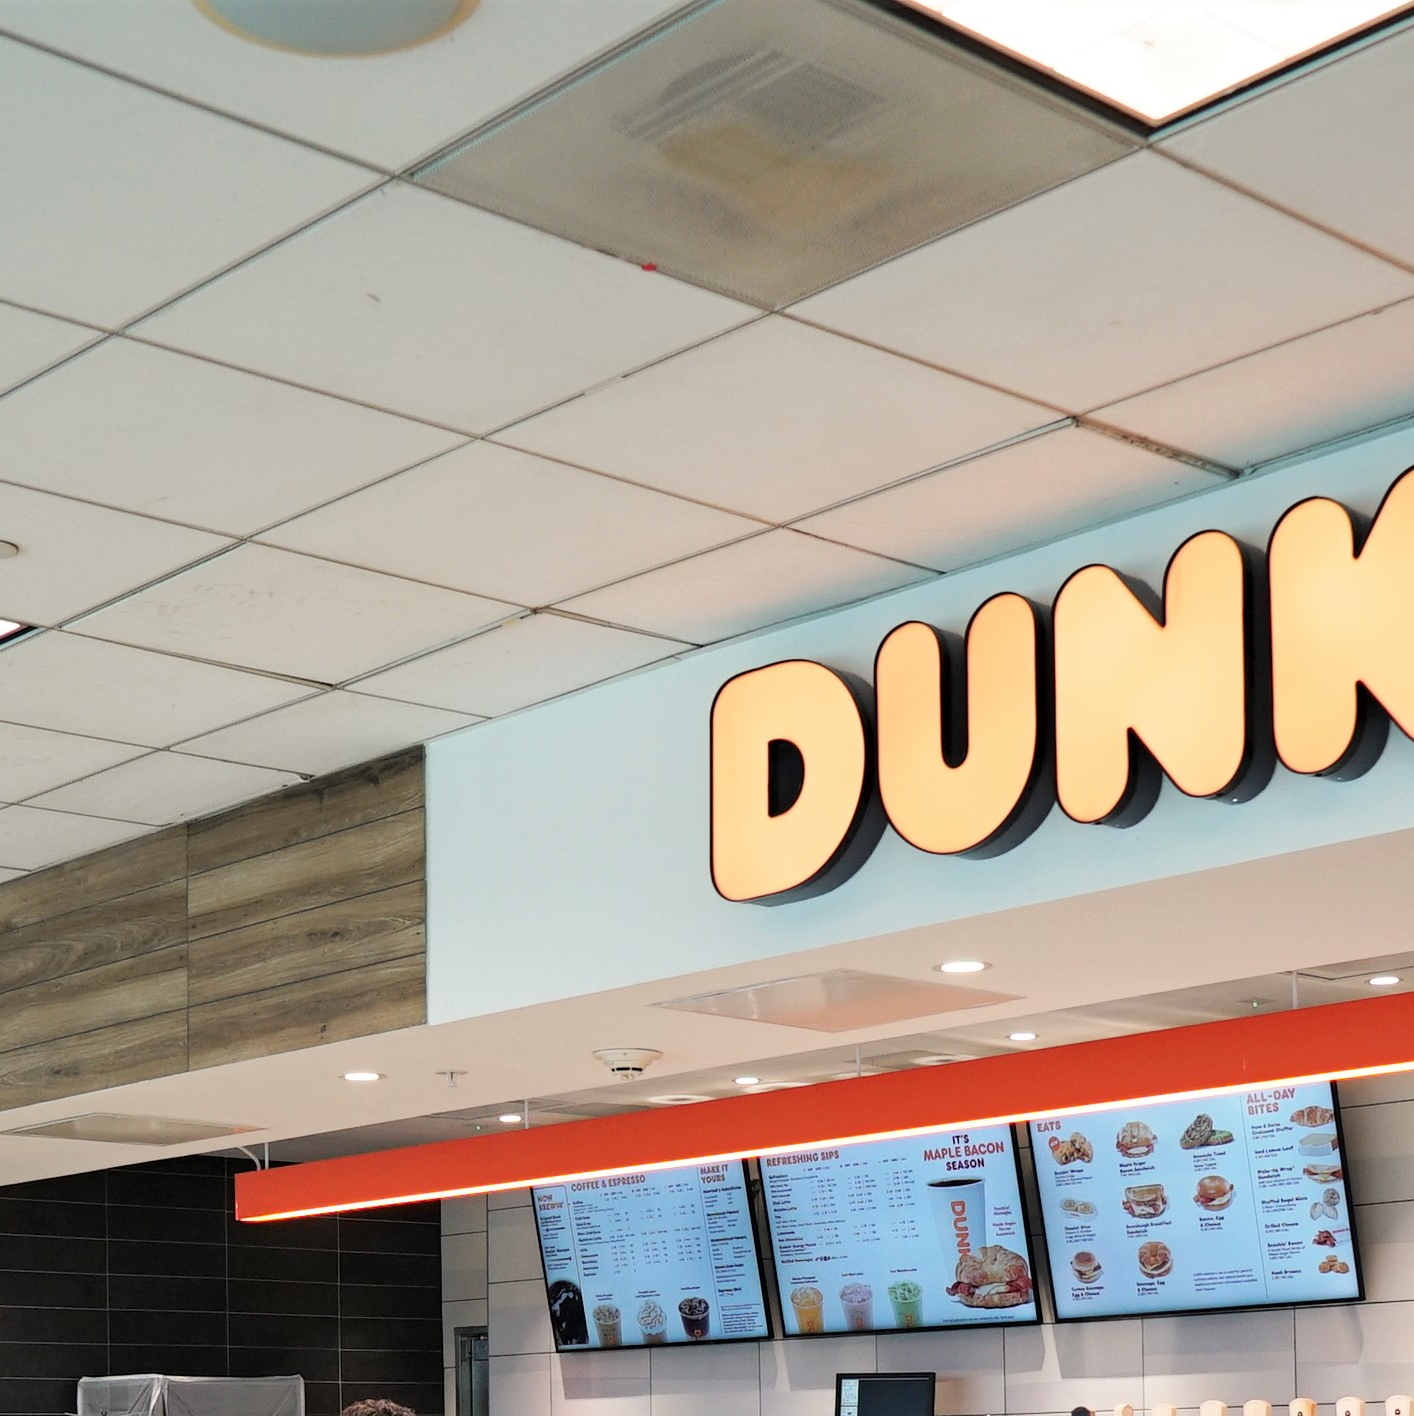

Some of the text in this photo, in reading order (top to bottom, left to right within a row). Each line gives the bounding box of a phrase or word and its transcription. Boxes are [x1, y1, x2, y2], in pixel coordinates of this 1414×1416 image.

[1247, 1087, 1295, 1104] ALL-DAY
[1248, 1102, 1279, 1115] BITES
[1037, 1120, 1061, 1133] EATS
[952, 1135, 969, 1144] IT'S
[924, 1142, 1004, 1161] MAPLE BACON
[767, 1153, 819, 1167] REFRESHING
[821, 1150, 839, 1160] SIPS
[946, 1158, 984, 1171] SEASON
[701, 1164, 728, 1175] MAKE IT
[571, 1182, 599, 1191] COFFEE
[608, 1175, 646, 1187] ESPRESSO
[701, 1174, 725, 1184] YOURS
